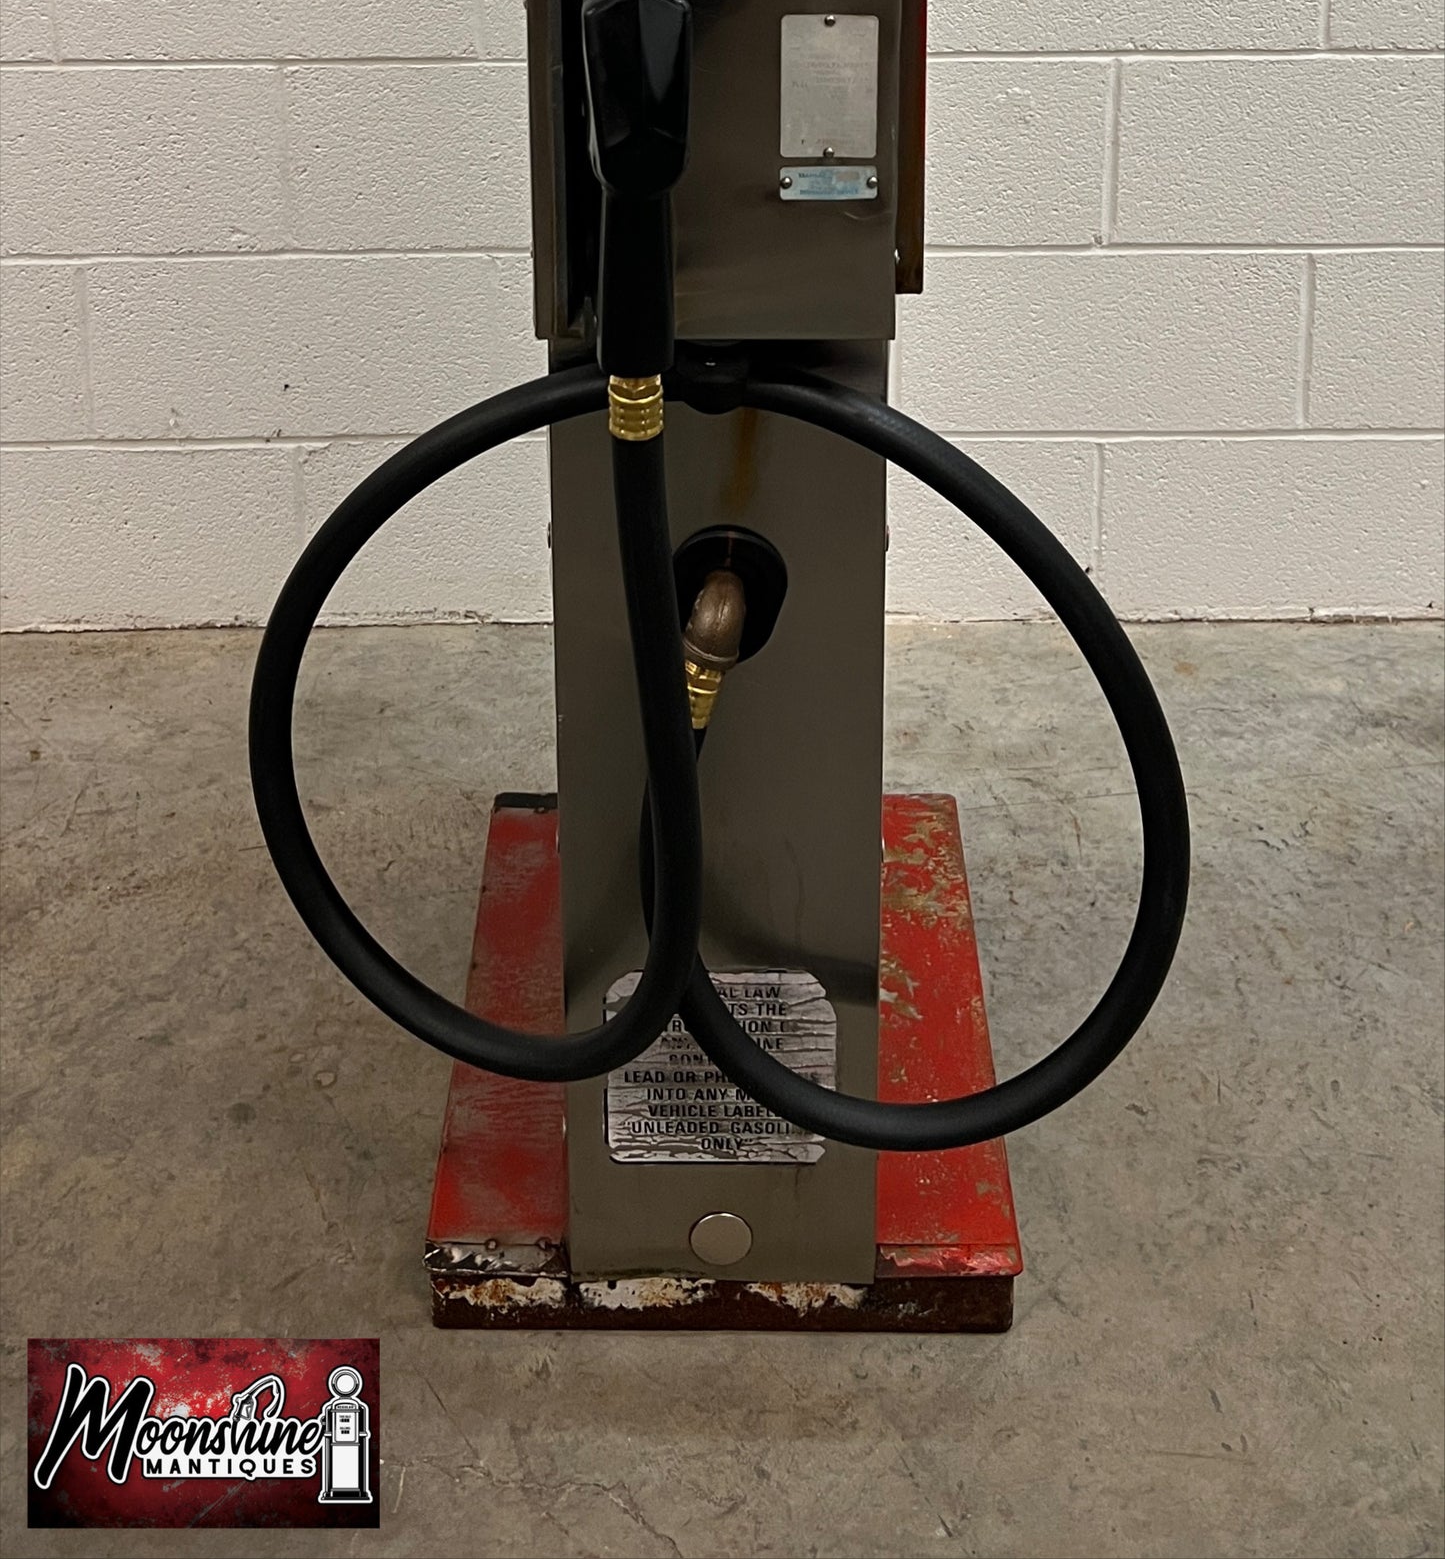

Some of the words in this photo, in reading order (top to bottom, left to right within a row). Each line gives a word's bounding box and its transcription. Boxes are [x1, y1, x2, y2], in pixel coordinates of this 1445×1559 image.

[745, 986, 782, 999] LAW
[756, 1003, 787, 1016] THE
[624, 1070, 665, 1083] LEAD
[673, 1070, 696, 1083] OR
[647, 1088, 687, 1101] INTO
[694, 1088, 729, 1101] ANY
[648, 1105, 717, 1118] VEHICLE
